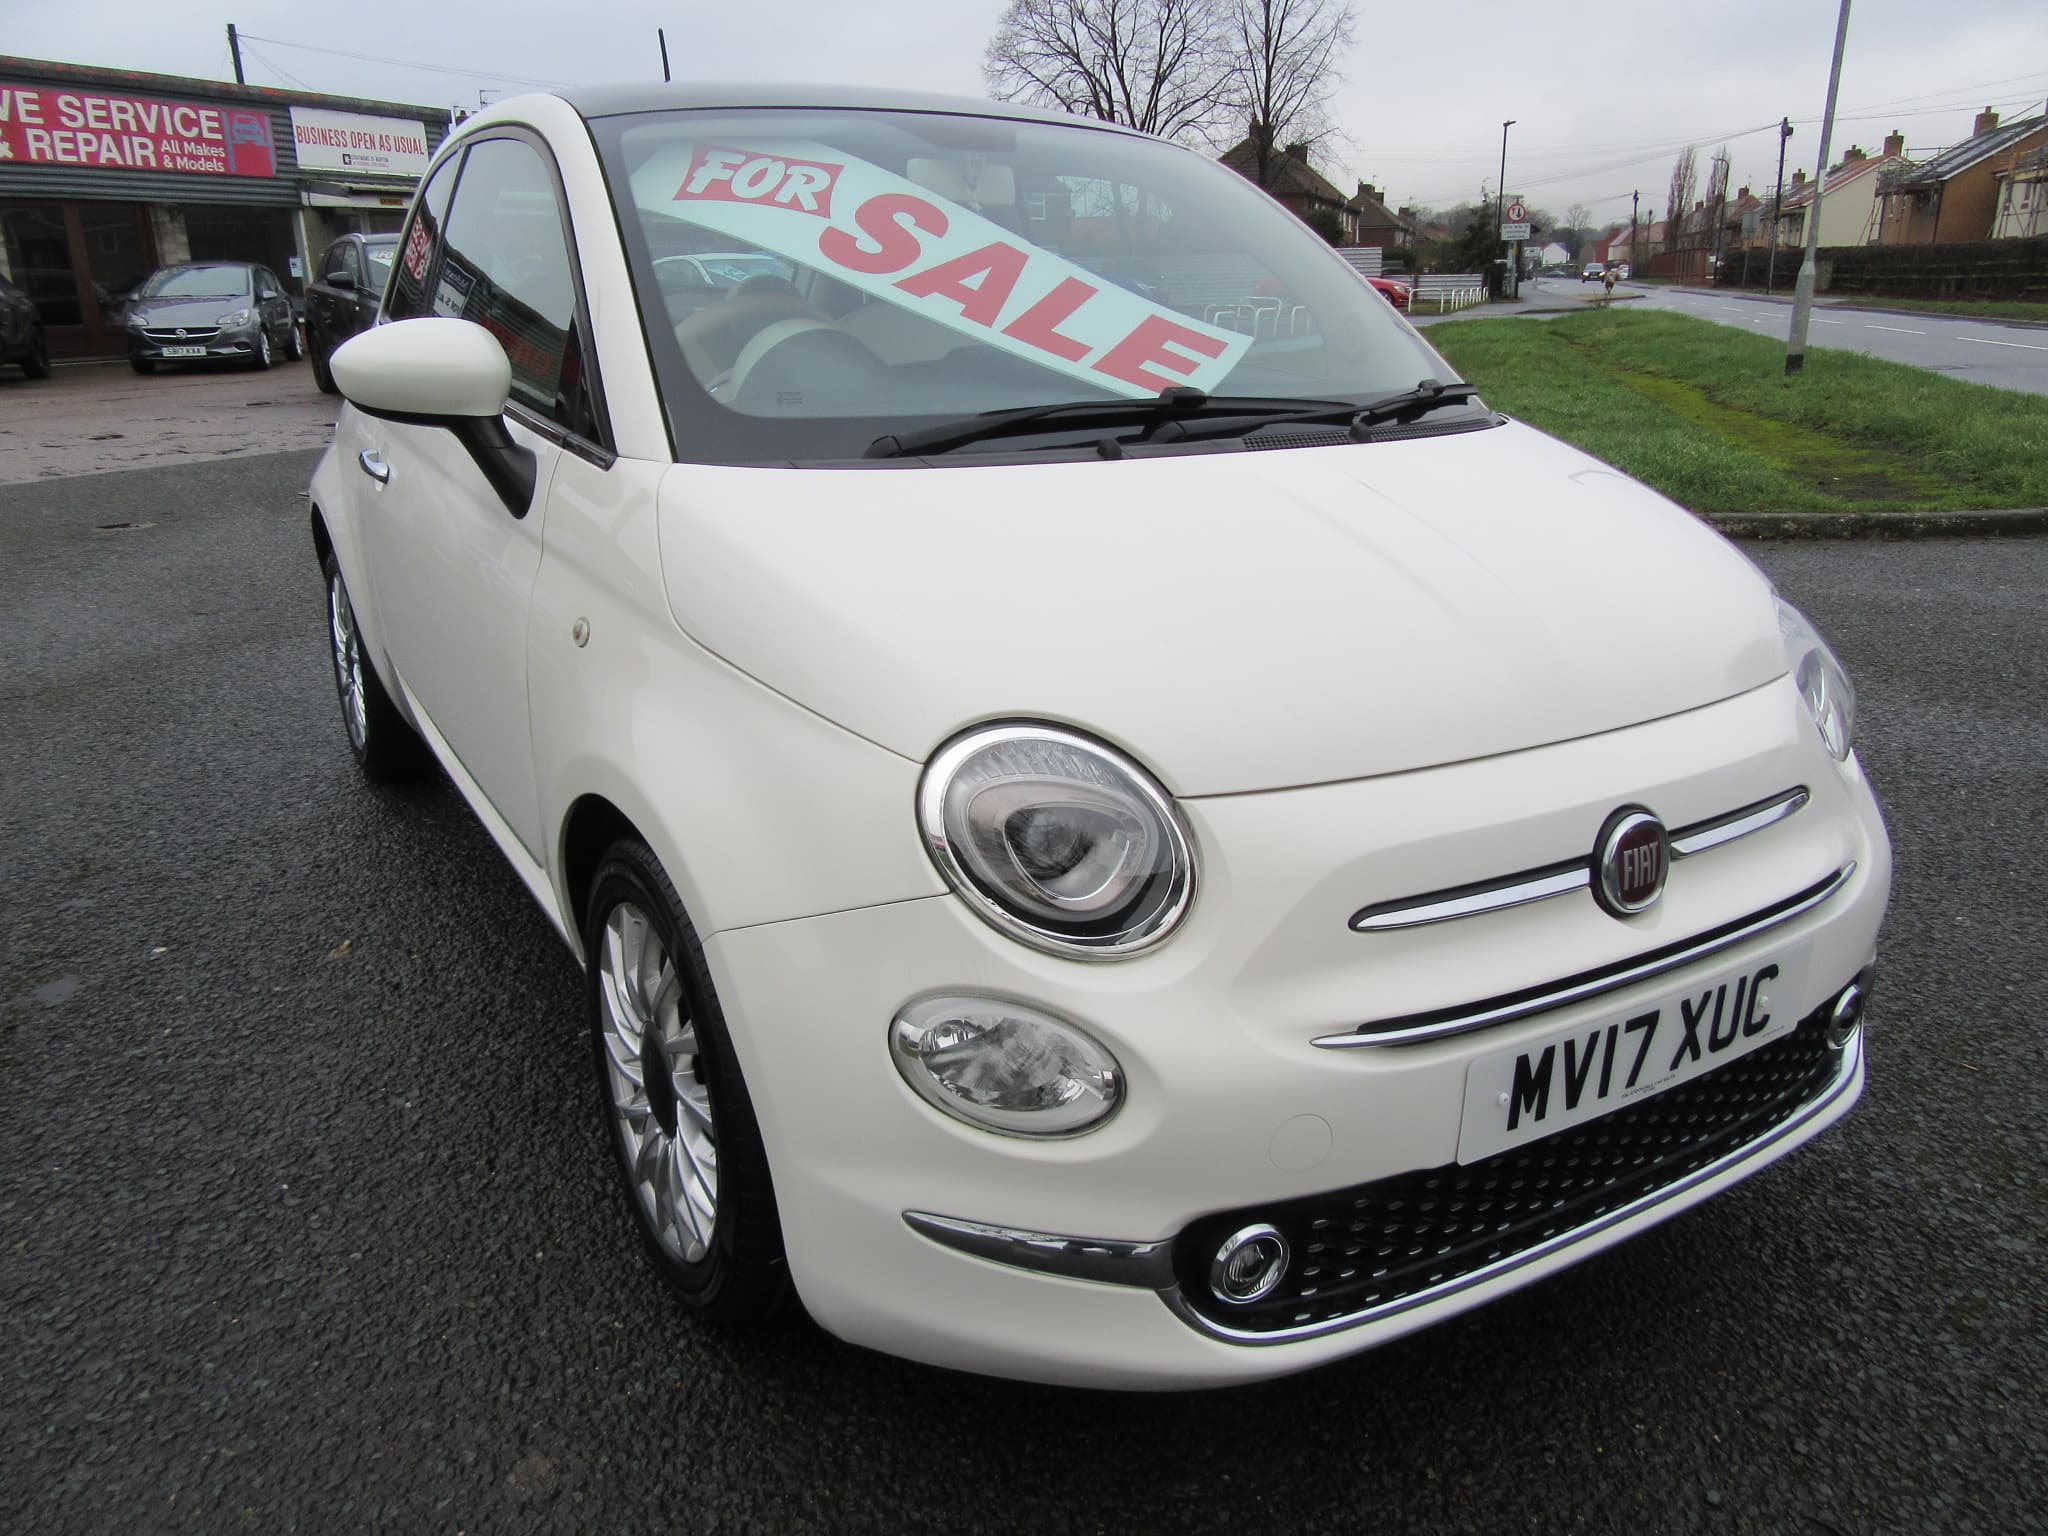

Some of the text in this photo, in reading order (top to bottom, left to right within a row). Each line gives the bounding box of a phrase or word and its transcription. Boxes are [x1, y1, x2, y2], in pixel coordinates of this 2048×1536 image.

[57, 94, 224, 140] SERVICE
[295, 124, 425, 156] BUSINESS OPEN AS USUAL
[25, 127, 157, 167] REPAIR
[161, 138, 226, 158] All Makes
[163, 153, 225, 173] & Models
[686, 151, 832, 212] FOR
[818, 193, 1229, 396] SALE
[1623, 841, 1659, 891] FIAT
[1506, 963, 1780, 1132] MV17 XUC
